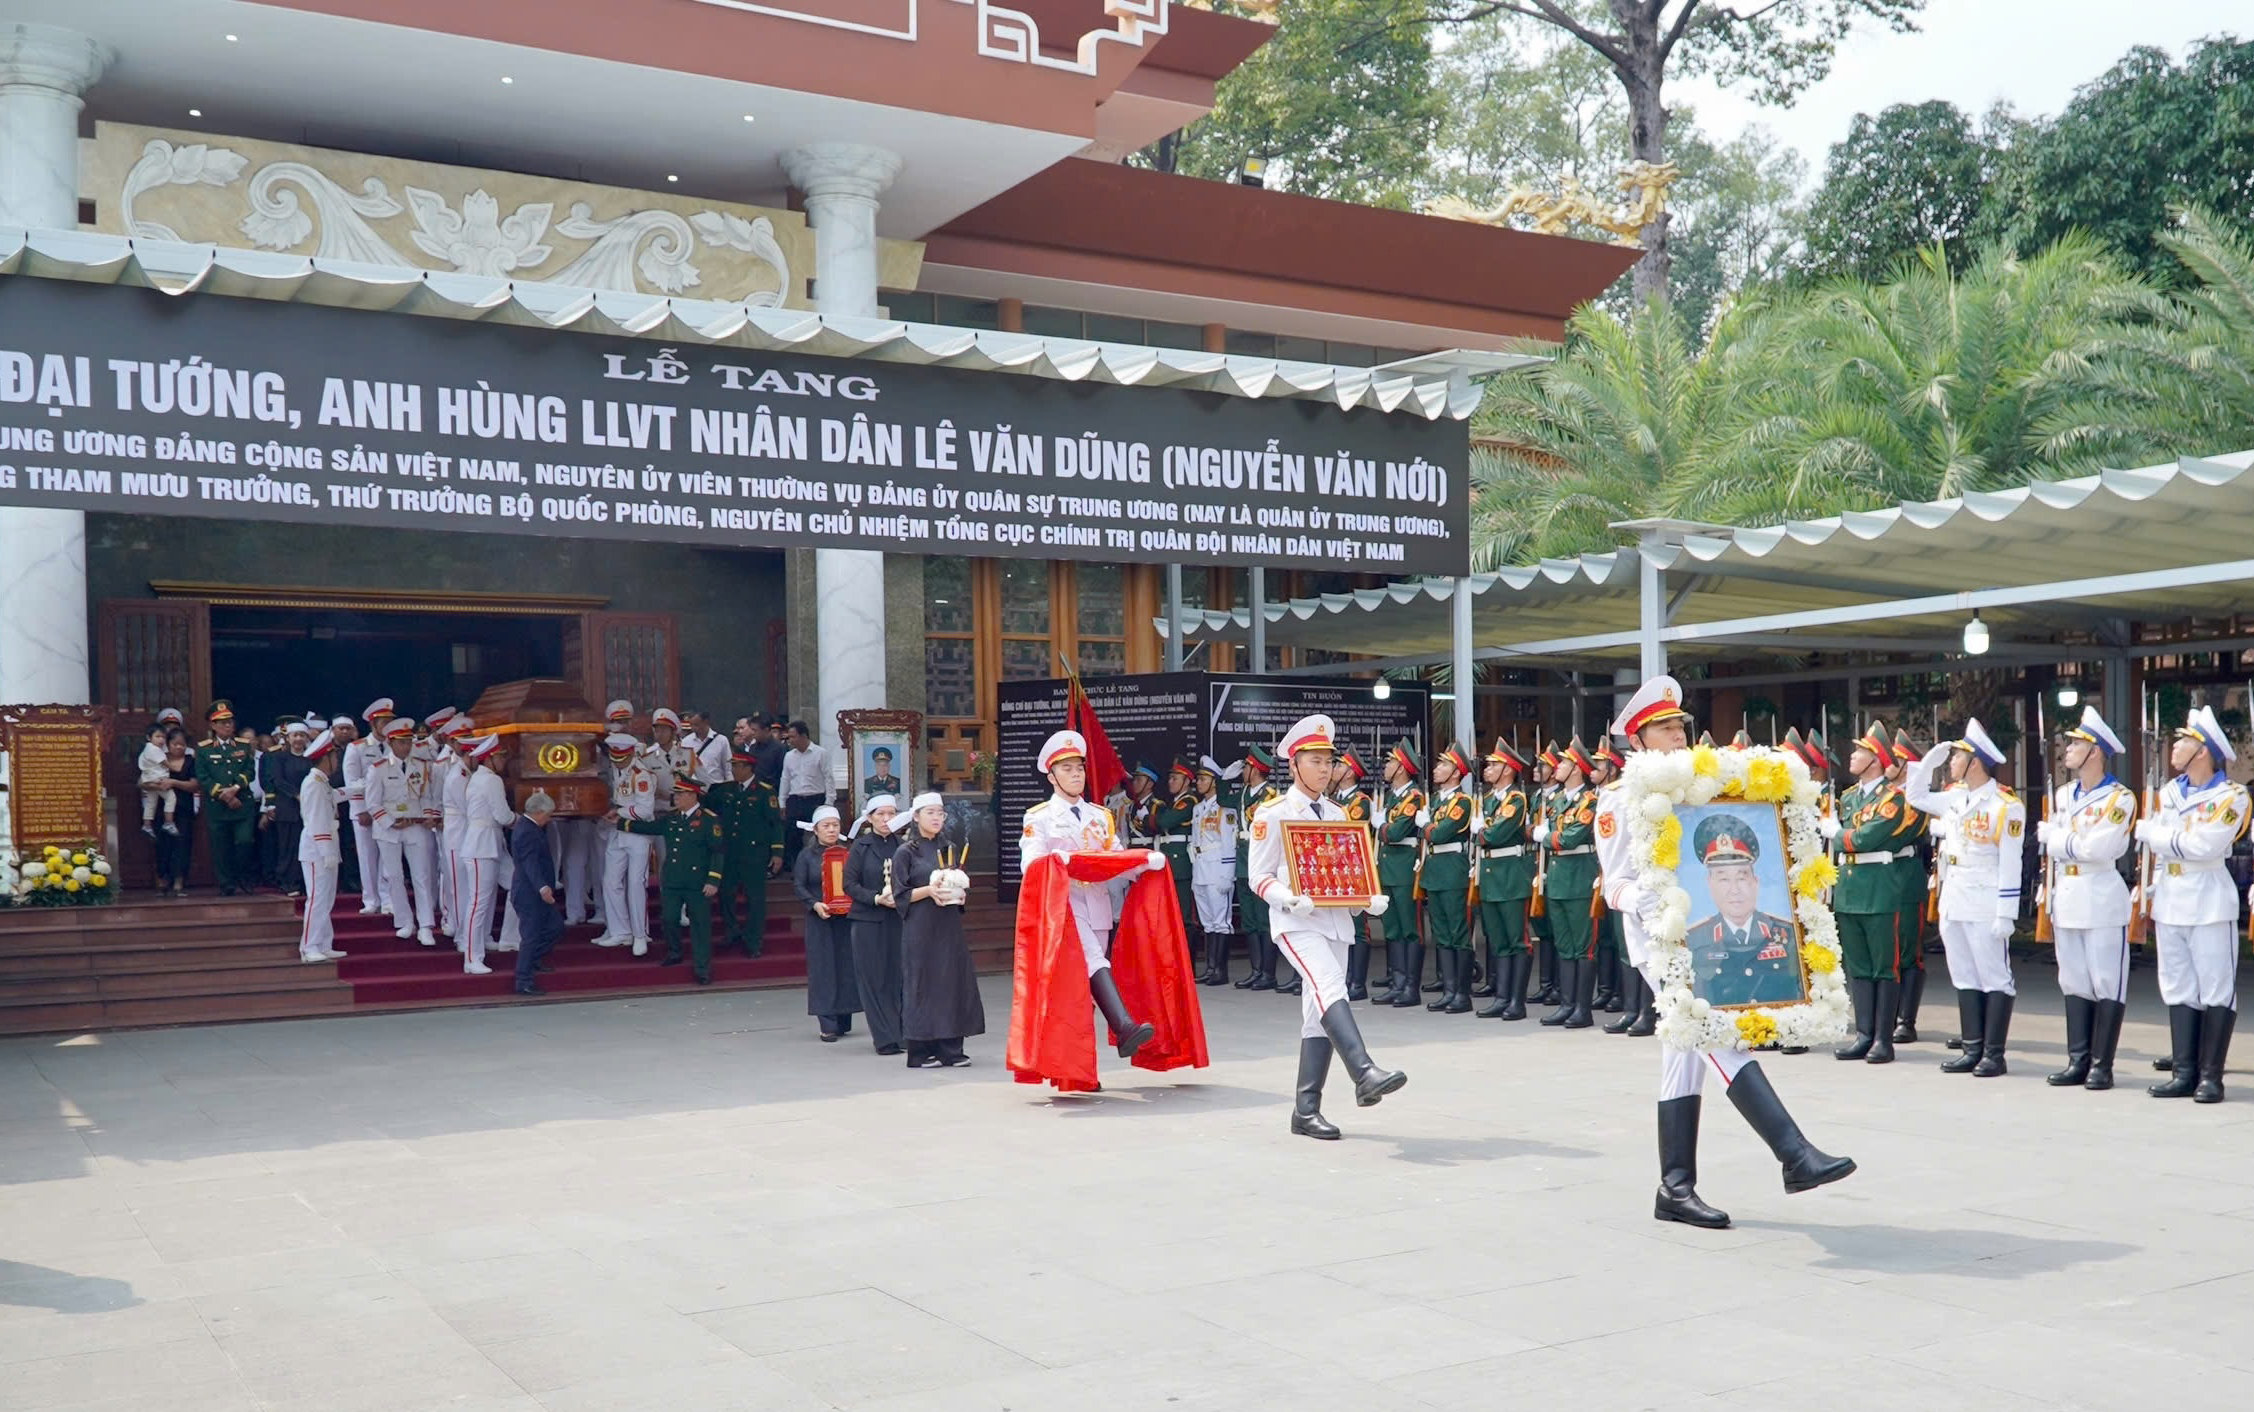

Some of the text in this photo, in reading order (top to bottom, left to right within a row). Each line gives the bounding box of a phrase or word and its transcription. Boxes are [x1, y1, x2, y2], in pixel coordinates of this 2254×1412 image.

[603, 347, 880, 402] LỄ TANG
[0, 350, 1448, 507] ĐẠI TƯỚNG, ANH HÙNG LLVT NHÂN DÂN LÊ VĂN DŨNG (NGUYỄN VĂN NỚI)
[25, 466, 112, 494] THAM
[121, 472, 189, 499] MƯU
[197, 473, 320, 509] TRƯỞNG,
[327, 482, 384, 509] THỨ
[388, 485, 493, 516] TRƯỞNG
[500, 493, 535, 523] BỘ
[542, 494, 609, 522] QUỐC
[616, 500, 705, 530] PHÒNG,
[711, 508, 803, 533] NGUYÊN
[809, 509, 854, 535] CHỦ
[859, 515, 929, 542] NHIỆM
[934, 514, 989, 542] TỔNG
[995, 523, 1035, 547] CỤC
[1041, 523, 1101, 547] CHÍNH
[1105, 529, 1136, 552] TRỊ
[1141, 529, 1191, 551] QUÂN
[1195, 531, 1227, 556] ĐỘI
[1232, 533, 1282, 555] NHÂN
[1286, 535, 1322, 557] DÂN
[1326, 538, 1362, 562] VIỆT
[1366, 543, 1405, 562] NAM
[64, 430, 147, 459] ƯƠNG
[155, 432, 237, 465] ĐẢNG
[245, 440, 323, 472] CỘNG
[331, 445, 389, 475] SẢN
[396, 451, 453, 482] VIỆT
[460, 458, 528, 486] NAM,
[536, 464, 635, 490] NGUYÊN
[642, 464, 673, 492] ỦY
[679, 471, 732, 498] VIÊN
[738, 475, 828, 502] THƯỜNG
[834, 483, 862, 508] VỤ
[868, 480, 927, 508] ĐẢNG
[933, 483, 960, 509] ỦY
[965, 489, 1021, 513] QUÂN
[1027, 494, 1055, 519] SỰ
[1058, 496, 1122, 519] TRUNG
[1127, 500, 1179, 522] ƯƠNG
[1184, 504, 1226, 524] (NAY
[1231, 504, 1253, 525] LÀ
[1257, 506, 1305, 528] QUÂN
[1310, 506, 1334, 529] ỦY
[1336, 512, 1391, 533] TRUNG
[1395, 516, 1450, 539] ƯƠNG),
[1118, 685, 1140, 693] TANG
[1302, 692, 1317, 700] TIN
